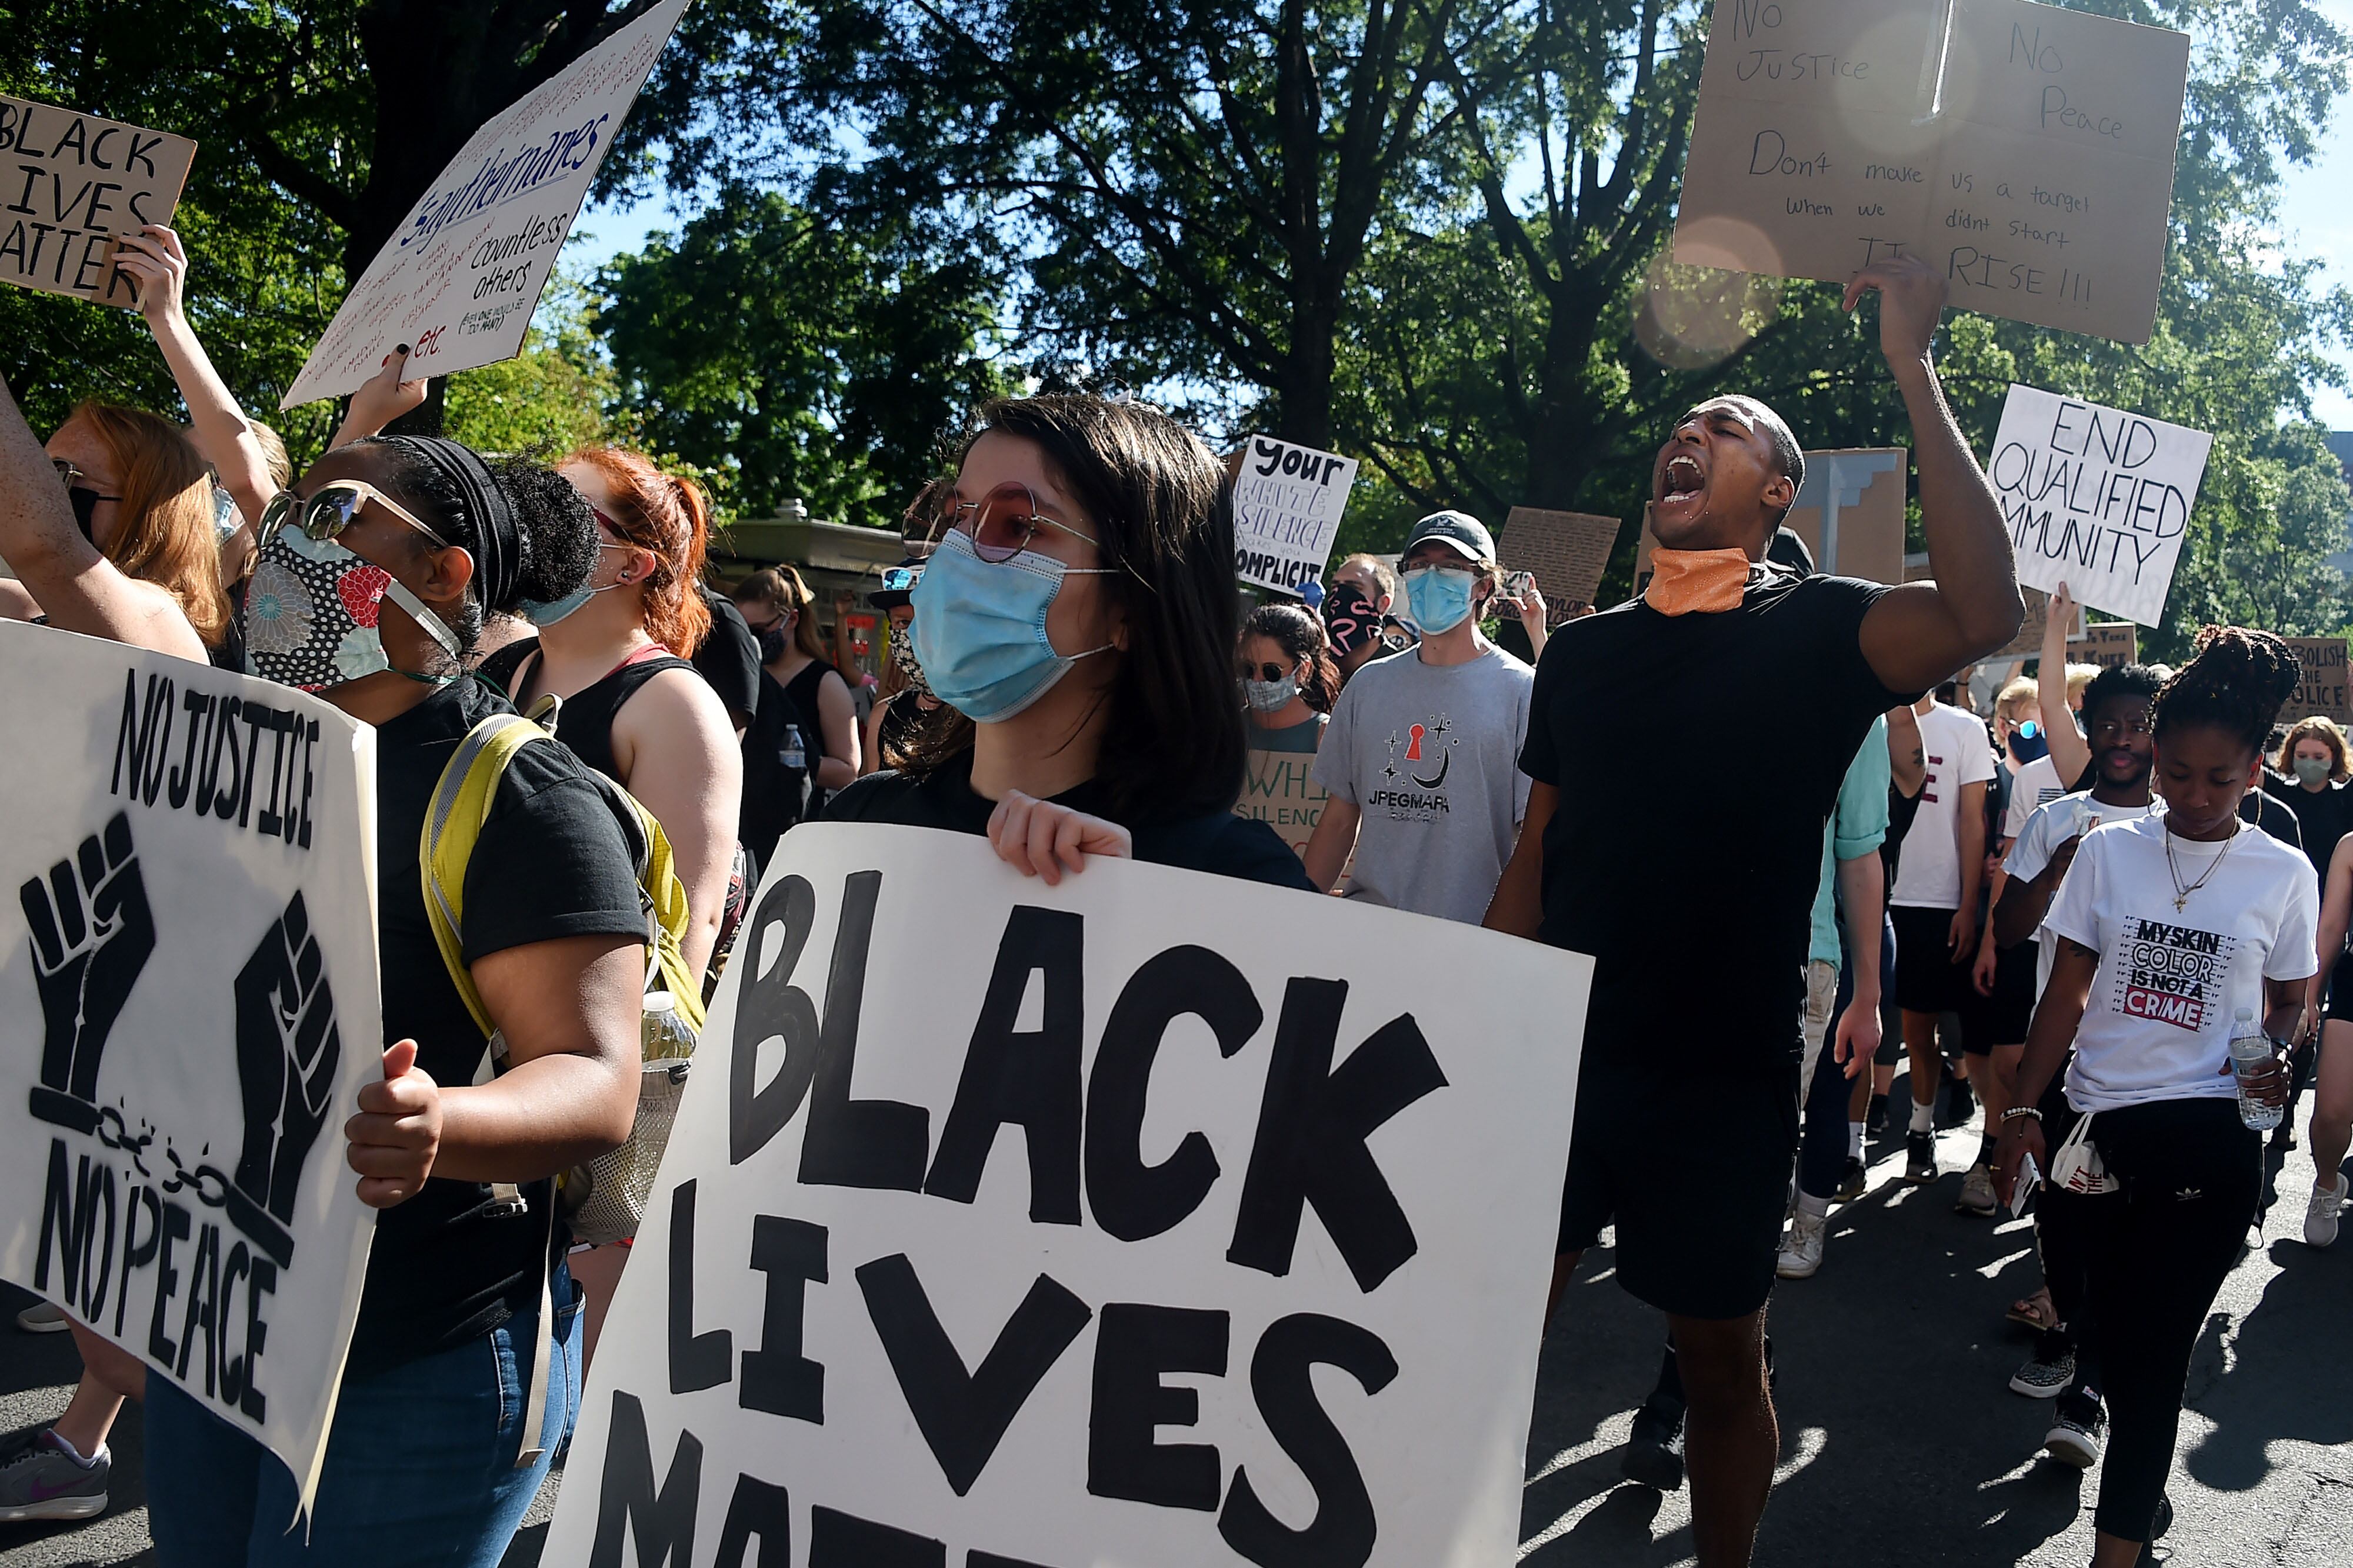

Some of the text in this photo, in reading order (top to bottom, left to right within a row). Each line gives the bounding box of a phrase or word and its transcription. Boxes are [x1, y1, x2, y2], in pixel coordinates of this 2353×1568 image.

[1734, 0, 1781, 41] No
[2011, 23, 2063, 74] No
[2041, 85, 2123, 139] Peace
[0, 101, 163, 178] BLACK
[0, 165, 152, 237] IVES
[401, 113, 609, 255] #saytheirnames
[1866, 164, 1925, 183] make
[1997, 182, 2014, 199] a
[2030, 185, 2089, 213] target
[471, 213, 568, 269] countless
[1858, 203, 1885, 216] we
[1945, 209, 1991, 232] didnt
[0, 220, 141, 303] ATTER
[474, 261, 532, 300] others
[414, 325, 446, 358] etc.
[2051, 402, 2157, 469] END
[1255, 439, 1345, 486] your
[1237, 476, 1331, 516] WHITE
[1994, 442, 2187, 538] QUALIFIED
[1241, 503, 1333, 553] SILENCE
[2000, 495, 2161, 585] MMUNITY
[1237, 549, 1321, 588] OMPLICIT
[2291, 645, 2348, 668] BOLISH
[2301, 670, 2321, 683] HE
[2292, 685, 2343, 706] OLICE
[111, 668, 319, 850] NO JUSTICE
[1237, 803, 1319, 828] SILENC
[2132, 942, 2213, 983] COLOR
[2127, 990, 2202, 1029] CRIME
[729, 870, 1448, 1294] BLACK
[2087, 1173, 2103, 1193] THE
[34, 1138, 278, 1425] NO PEACE
[668, 1179, 1399, 1568] LIVES
